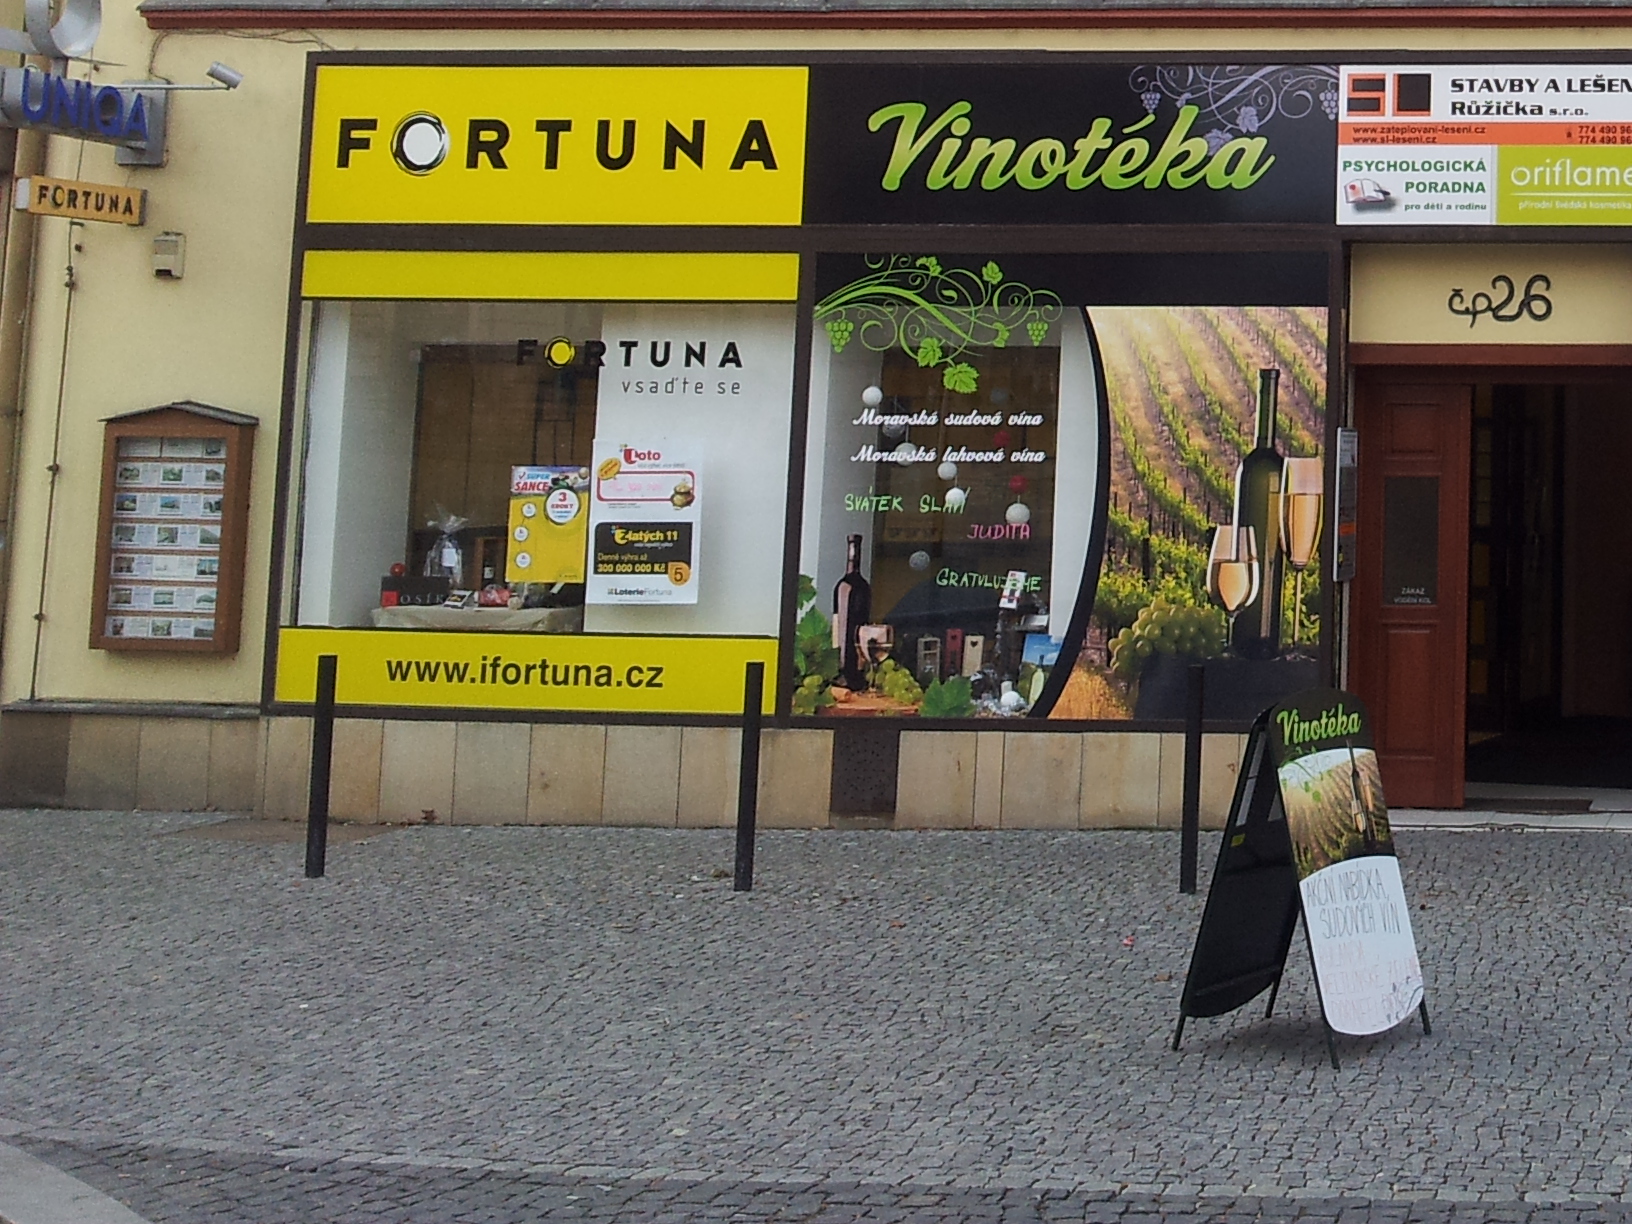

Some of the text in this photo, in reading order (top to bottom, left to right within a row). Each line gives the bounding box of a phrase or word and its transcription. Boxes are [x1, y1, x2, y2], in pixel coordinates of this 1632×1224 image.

[1450, 78, 1539, 93] STAVBY
[1544, 78, 1560, 93] A
[21, 68, 149, 142] UNIQA
[1450, 100, 1589, 116] Růžička s.r.o.
[1578, 126, 1596, 134] 774
[336, 110, 779, 176] FORTUNA
[868, 101, 1276, 191] Vinotéka
[1579, 136, 1596, 144] 774
[1342, 157, 1487, 172] PSYCHOLOGICKÁ
[1404, 182, 1486, 193] PORADNA
[37, 184, 134, 215] FORTUNA
[1404, 204, 1420, 212] pro
[1455, 202, 1487, 210] rodinu
[516, 336, 743, 369] FORTUNA
[621, 377, 741, 394] vsaďte se
[852, 408, 1044, 425] Moravská sudová vína
[850, 444, 1047, 462] Moravská lahvová vína
[558, 492, 567, 502] 3
[844, 486, 904, 512] SVÁTEK
[666, 531, 678, 540] 11
[967, 523, 1031, 539] JUDITA
[674, 567, 683, 582] 5
[386, 656, 664, 688] www.ifortuna.cz
[1277, 703, 1362, 745] Vinotéka
